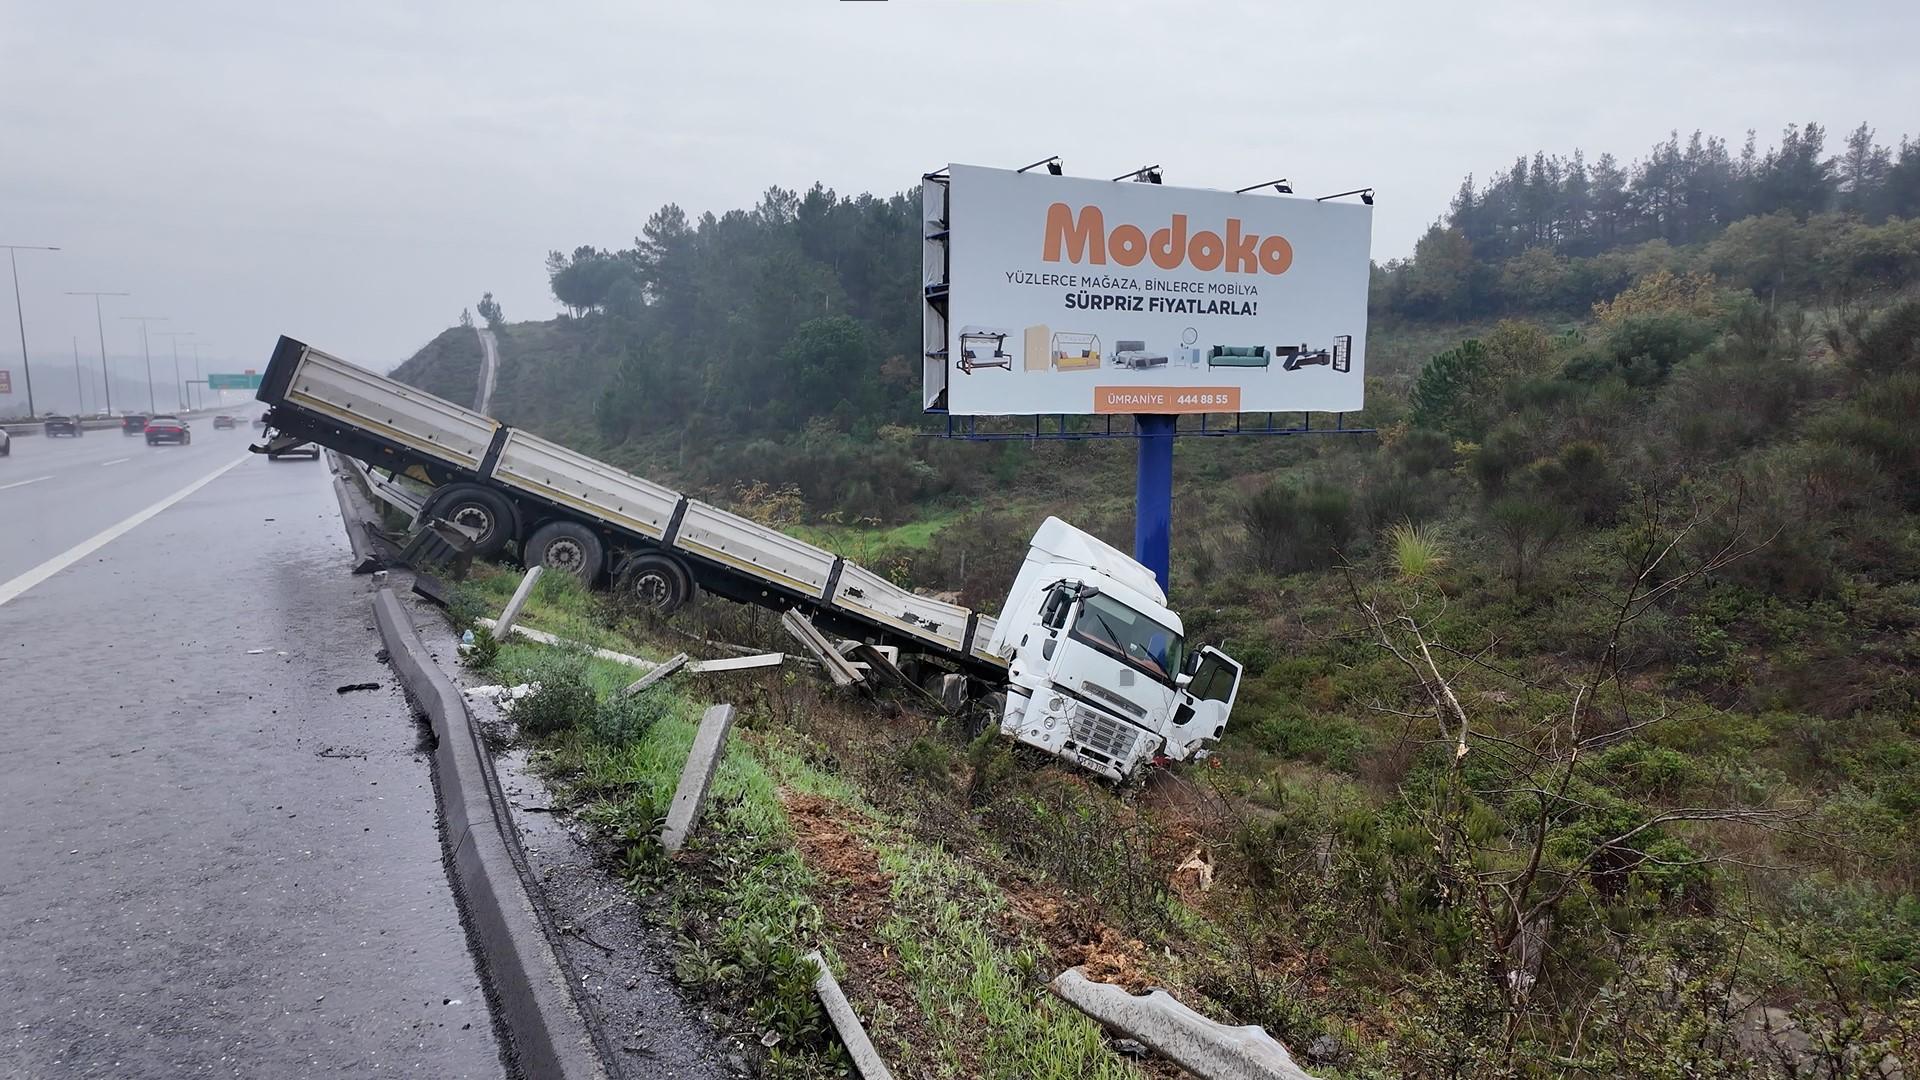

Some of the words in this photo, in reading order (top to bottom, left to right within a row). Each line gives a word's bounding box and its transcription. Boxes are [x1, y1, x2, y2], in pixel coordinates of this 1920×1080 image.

[1043, 202, 1294, 275] Modoko
[1005, 270, 1077, 287] YÜZLERCE
[1081, 275, 1141, 292] MAĞAZA,
[1145, 278, 1204, 293] BİNLERCE
[1208, 282, 1258, 296] MOBİLYA
[1108, 393, 1164, 405] ÜMRANİYE
[1177, 394, 1198, 404] 444
[1200, 394, 1213, 404] 88
[1215, 394, 1228, 404] 55
